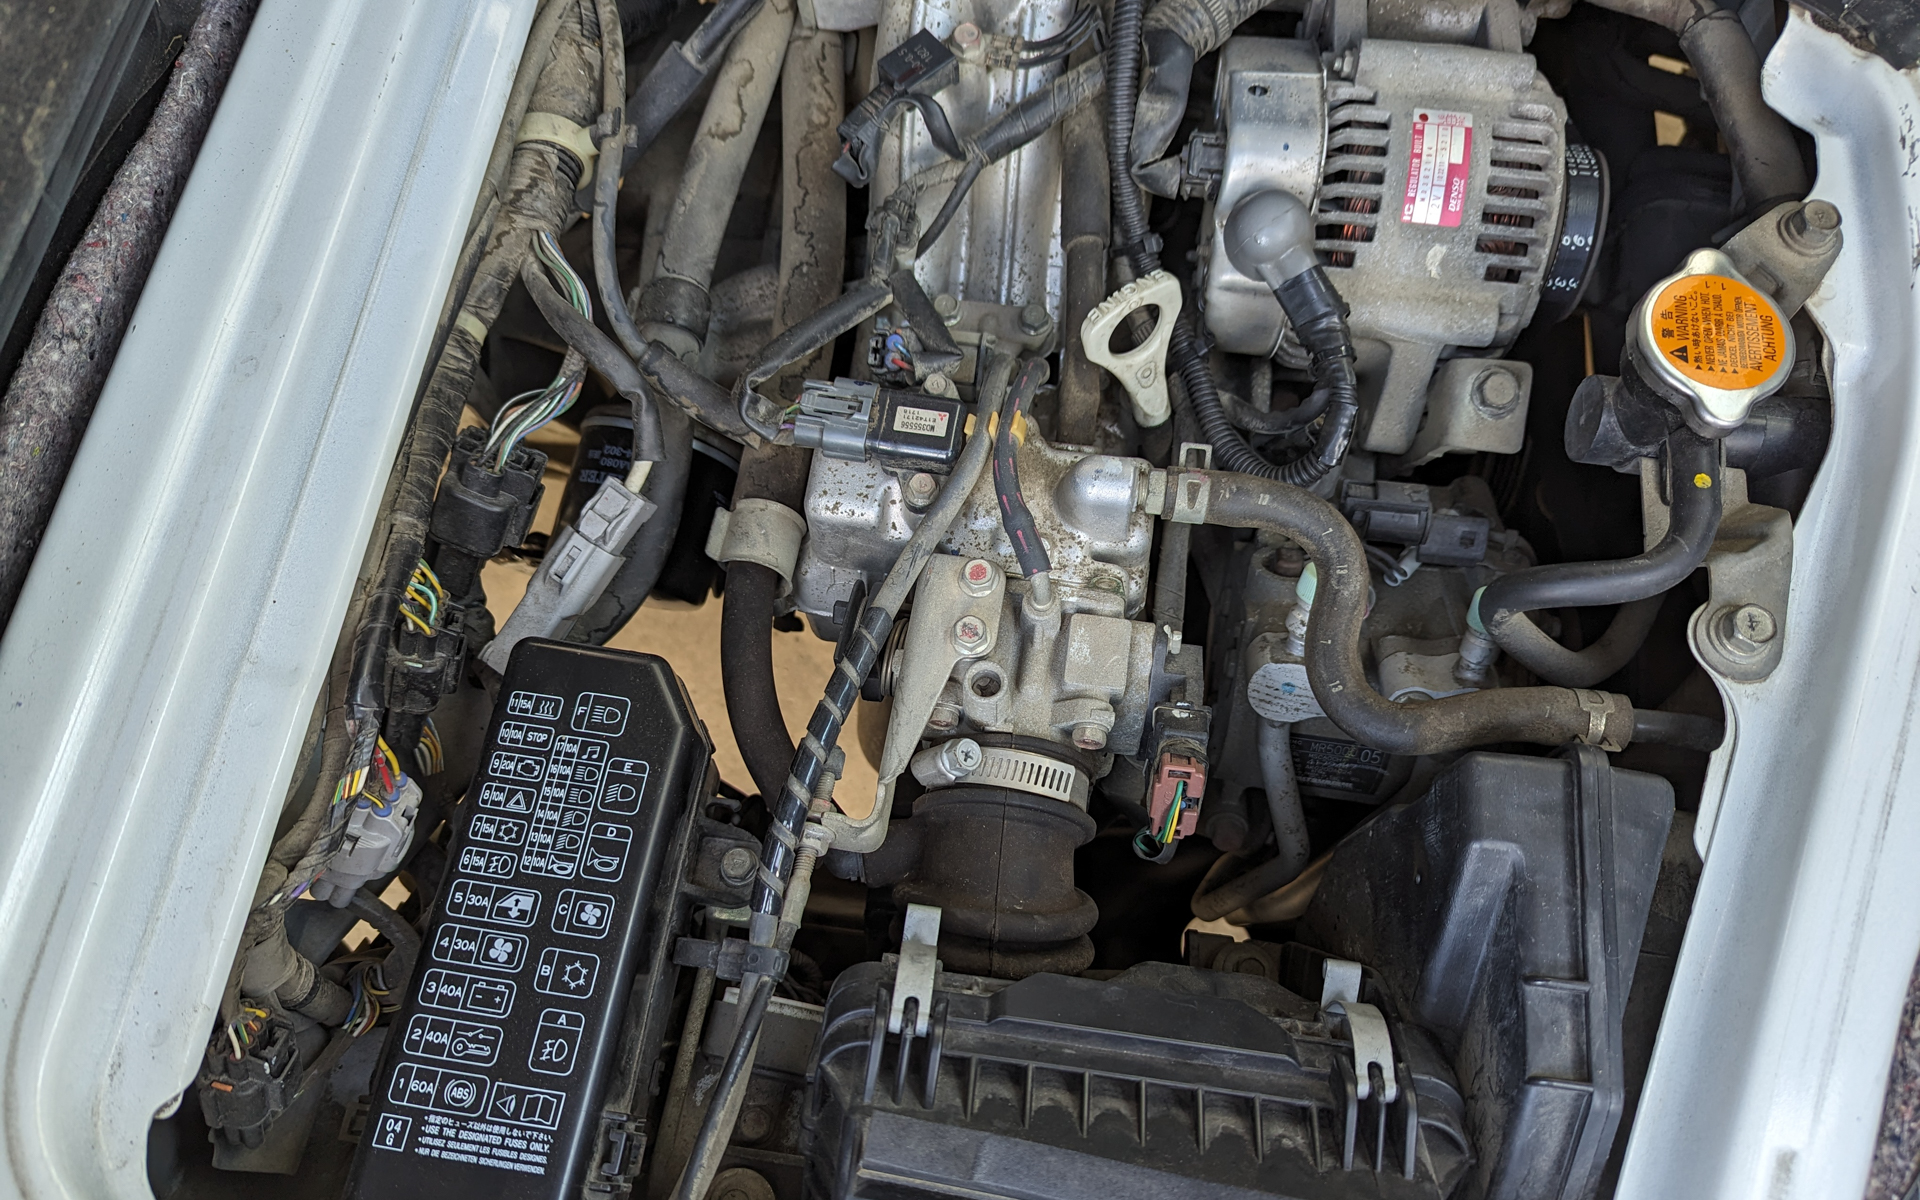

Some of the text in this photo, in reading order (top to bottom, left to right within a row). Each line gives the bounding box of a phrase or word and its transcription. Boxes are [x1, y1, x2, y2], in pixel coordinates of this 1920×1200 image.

[914, 44, 933, 62] 1821
[1413, 135, 1422, 153] BUILT
[1408, 158, 1420, 197] REGULATOR
[1448, 177, 1460, 212] DENSO
[1403, 203, 1414, 220] IC
[1087, 269, 1164, 324] ENGINE
[1674, 295, 1689, 340] WARNING
[1701, 307, 1711, 325] WHEN
[1736, 314, 1744, 329] MOTOR
[1702, 326, 1713, 343] OPEN
[1726, 311, 1738, 368] DECKEL NICHT BEI
[1744, 302, 1763, 372] AVERTISSEMENT
[1760, 315, 1777, 362] ACHTUNG
[1705, 346, 1715, 365] NEVER
[1715, 338, 1727, 358] JAMAIS
[511, 698, 532, 709] 11 15A
[577, 706, 588, 716] F
[501, 728, 548, 743] 10 10A STOP
[556, 742, 578, 753] 17 10A
[493, 760, 514, 770] 9 20A
[550, 764, 571, 775] 16 10A
[623, 762, 633, 772] E
[483, 790, 505, 802] 8 10A
[544, 786, 565, 798] 15 10A
[537, 809, 558, 821] 14 10A
[475, 823, 494, 834] 7 15A
[607, 828, 616, 837] D
[531, 832, 552, 844] 13 10A
[463, 855, 484, 866] 6 15A
[524, 856, 545, 868] 12 10A
[454, 892, 489, 908] 5 30A
[558, 904, 568, 915] C
[439, 937, 475, 952] 4 30A
[540, 965, 551, 976] B
[426, 982, 462, 998] 3 40A
[557, 1014, 567, 1025] A
[411, 1029, 448, 1045] 2 40A
[399, 1078, 470, 1100] 1 60A ABS
[386, 1119, 402, 1133] 04
[386, 1133, 394, 1146] G
[425, 1126, 550, 1153] USE THE DESIGNATED FUSES ONLY.
[422, 1136, 446, 1147] UTILISEZ
[447, 1139, 479, 1153] SEULEMENT
[479, 1144, 490, 1154] LES
[492, 1146, 518, 1159] FUSIBLES
[418, 1147, 430, 1157] NUR
[431, 1149, 440, 1159] DIE
[441, 1151, 478, 1165] BEZEICHNETEN
[479, 1157, 514, 1171] SICHERUNGEN
